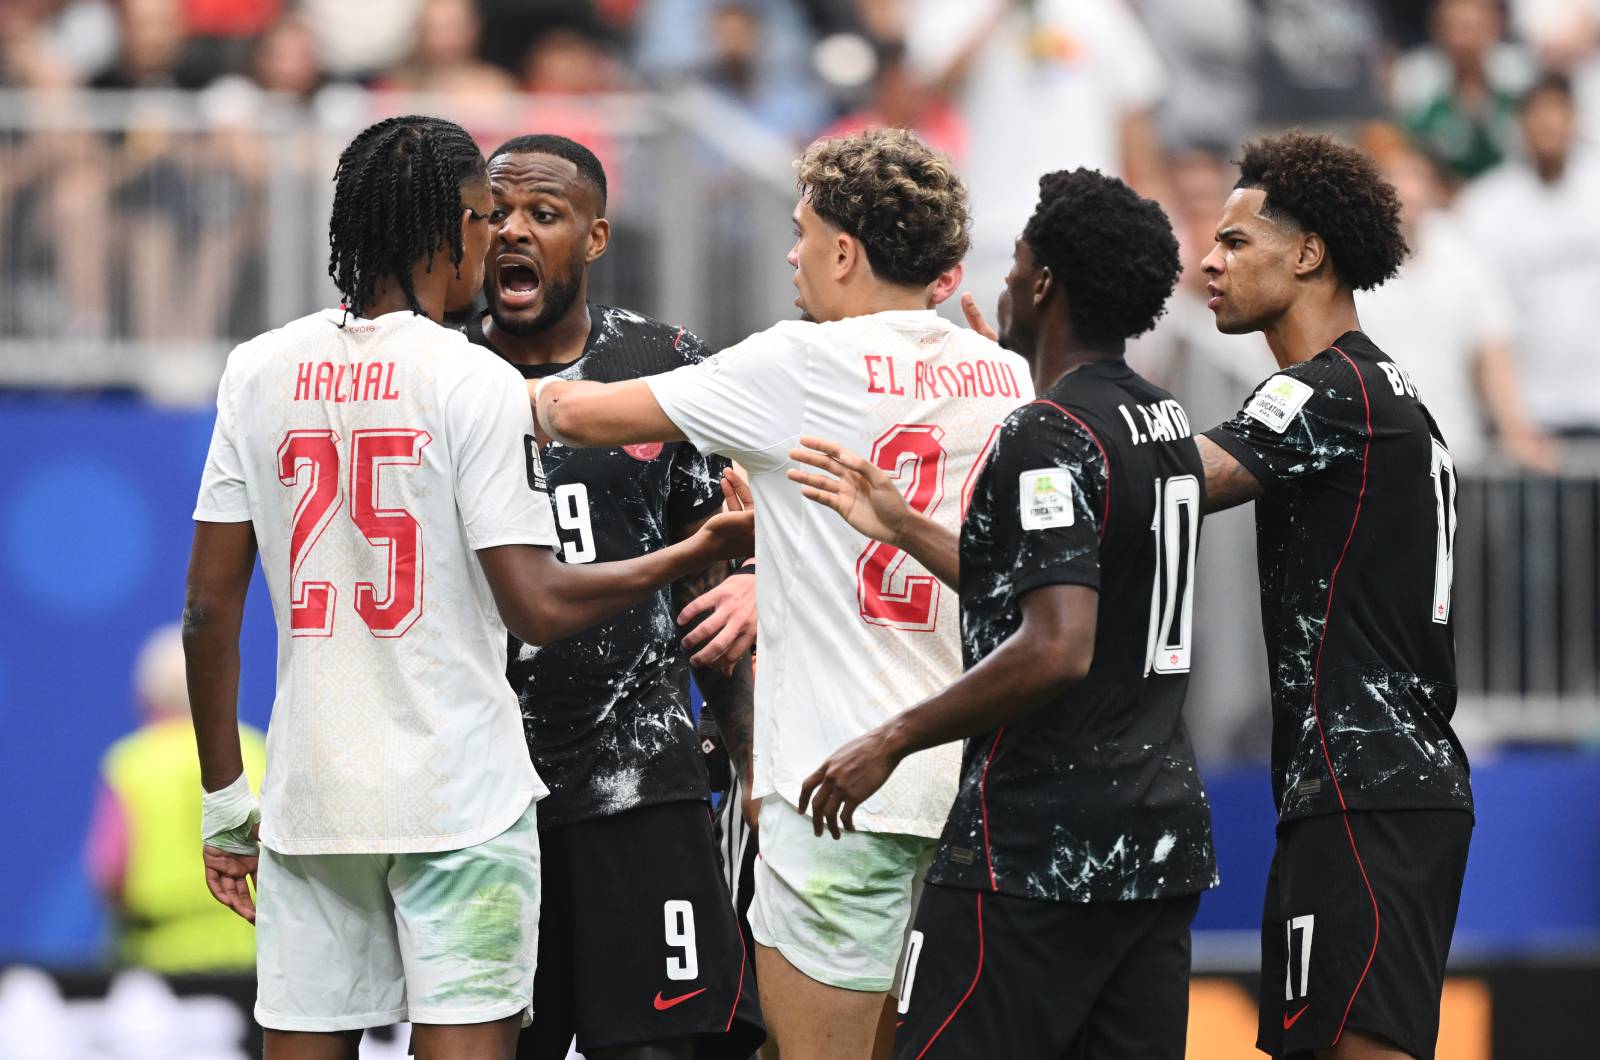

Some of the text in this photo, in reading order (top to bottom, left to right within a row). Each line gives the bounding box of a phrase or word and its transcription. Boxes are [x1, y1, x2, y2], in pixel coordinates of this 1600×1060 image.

[293, 361, 399, 403] HALHAL
[864, 354, 1021, 400] EL AYNAOUI
[276, 428, 433, 638] 25
[554, 482, 597, 564] 9
[855, 423, 1002, 633] 2
[664, 899, 699, 981] 9
[1285, 913, 1315, 1001] 17
